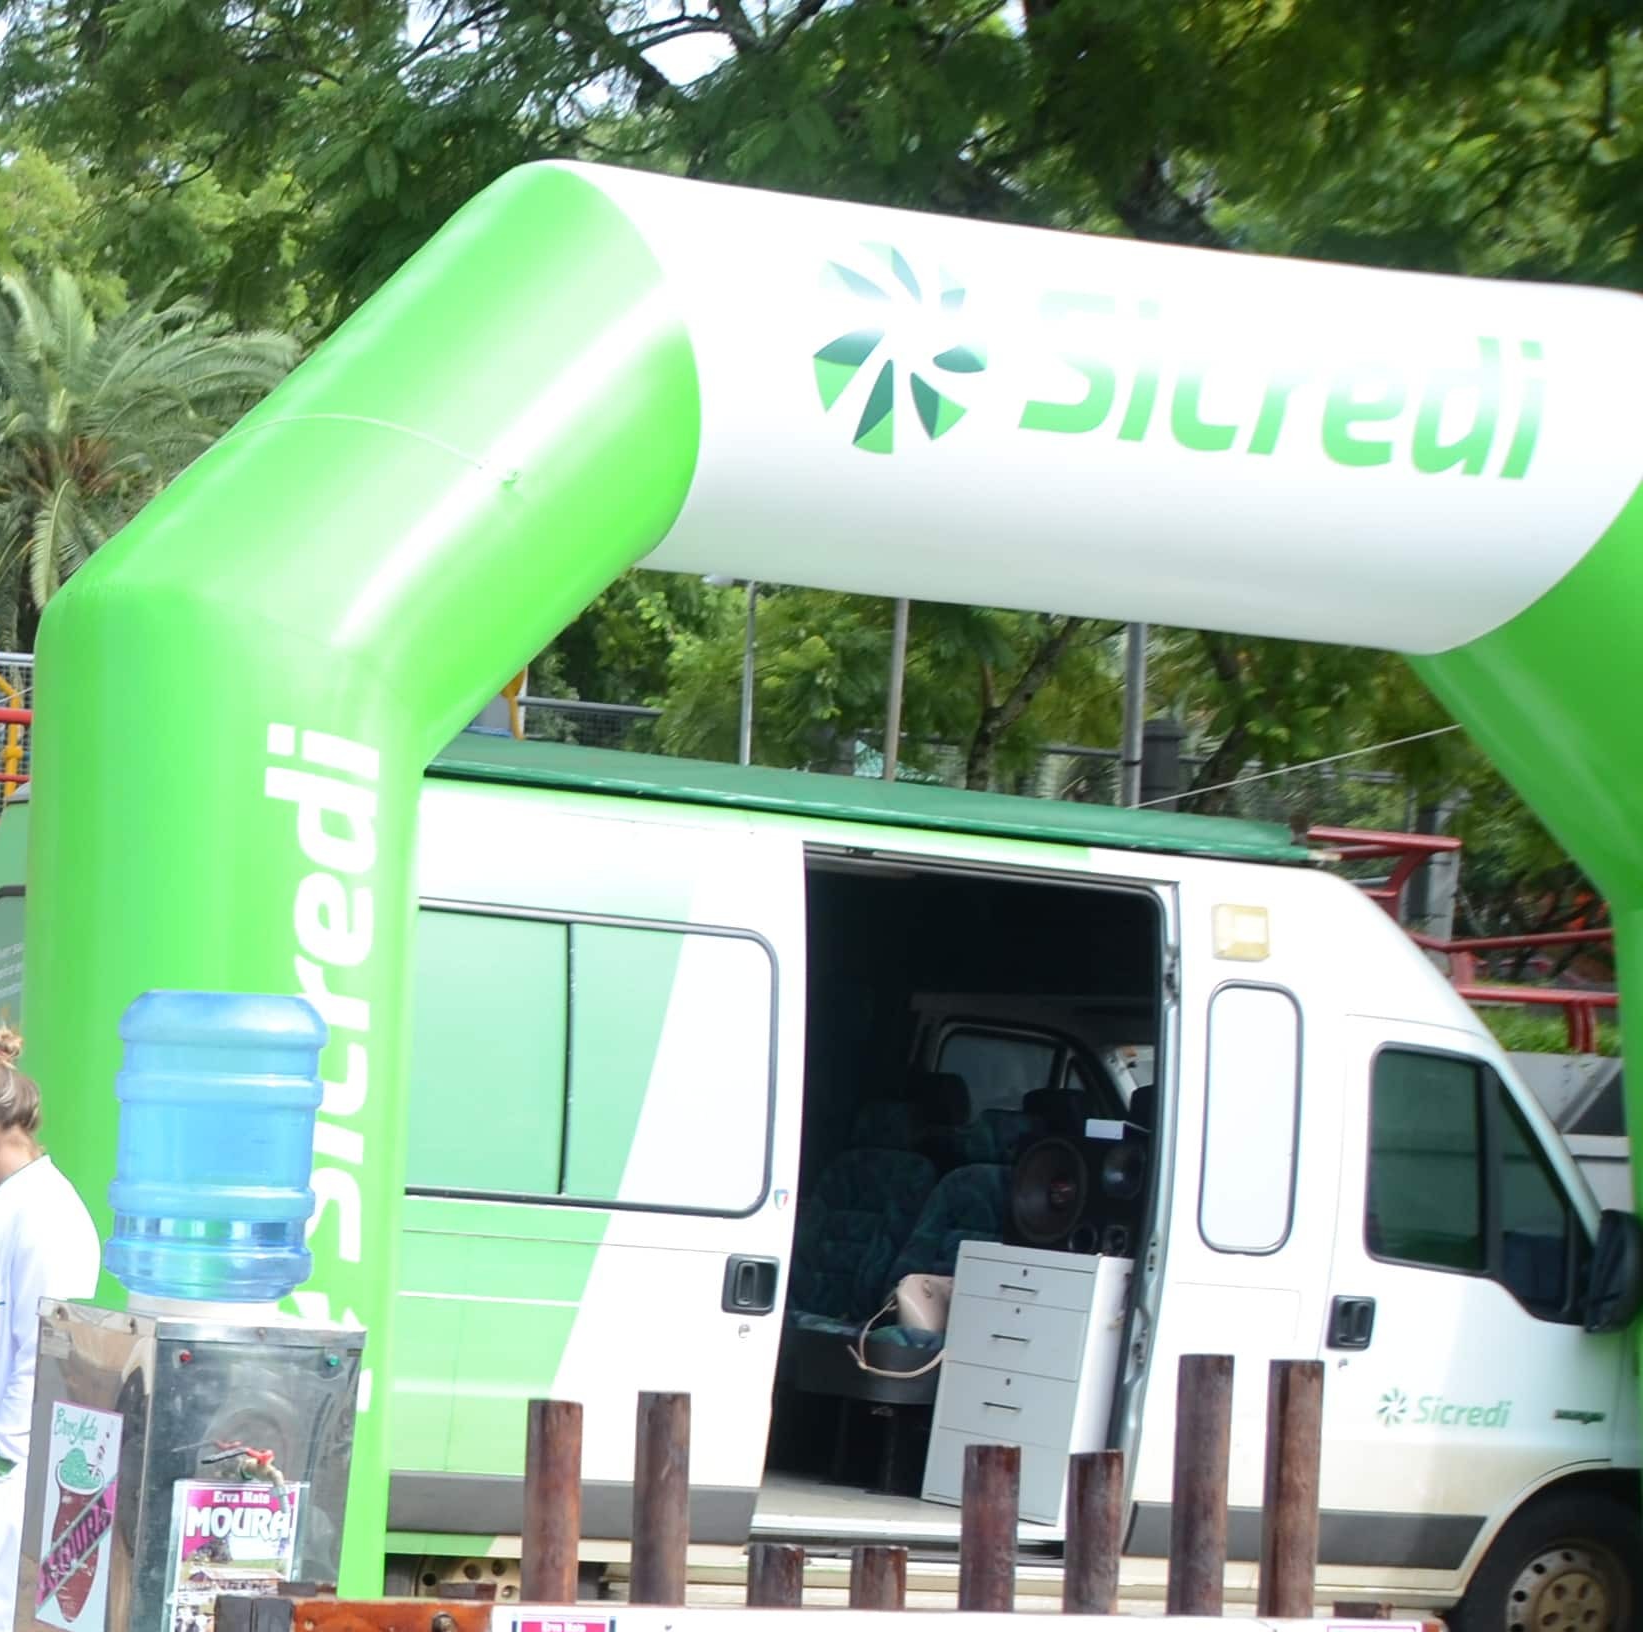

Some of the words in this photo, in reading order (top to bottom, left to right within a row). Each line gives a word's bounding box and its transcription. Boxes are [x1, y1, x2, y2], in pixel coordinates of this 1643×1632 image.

[1018, 289, 1544, 480] Sicredi
[265, 722, 379, 1263] Sicredi
[1412, 1396, 1513, 1428] Sicredi
[186, 1506, 291, 1541] MOURA
